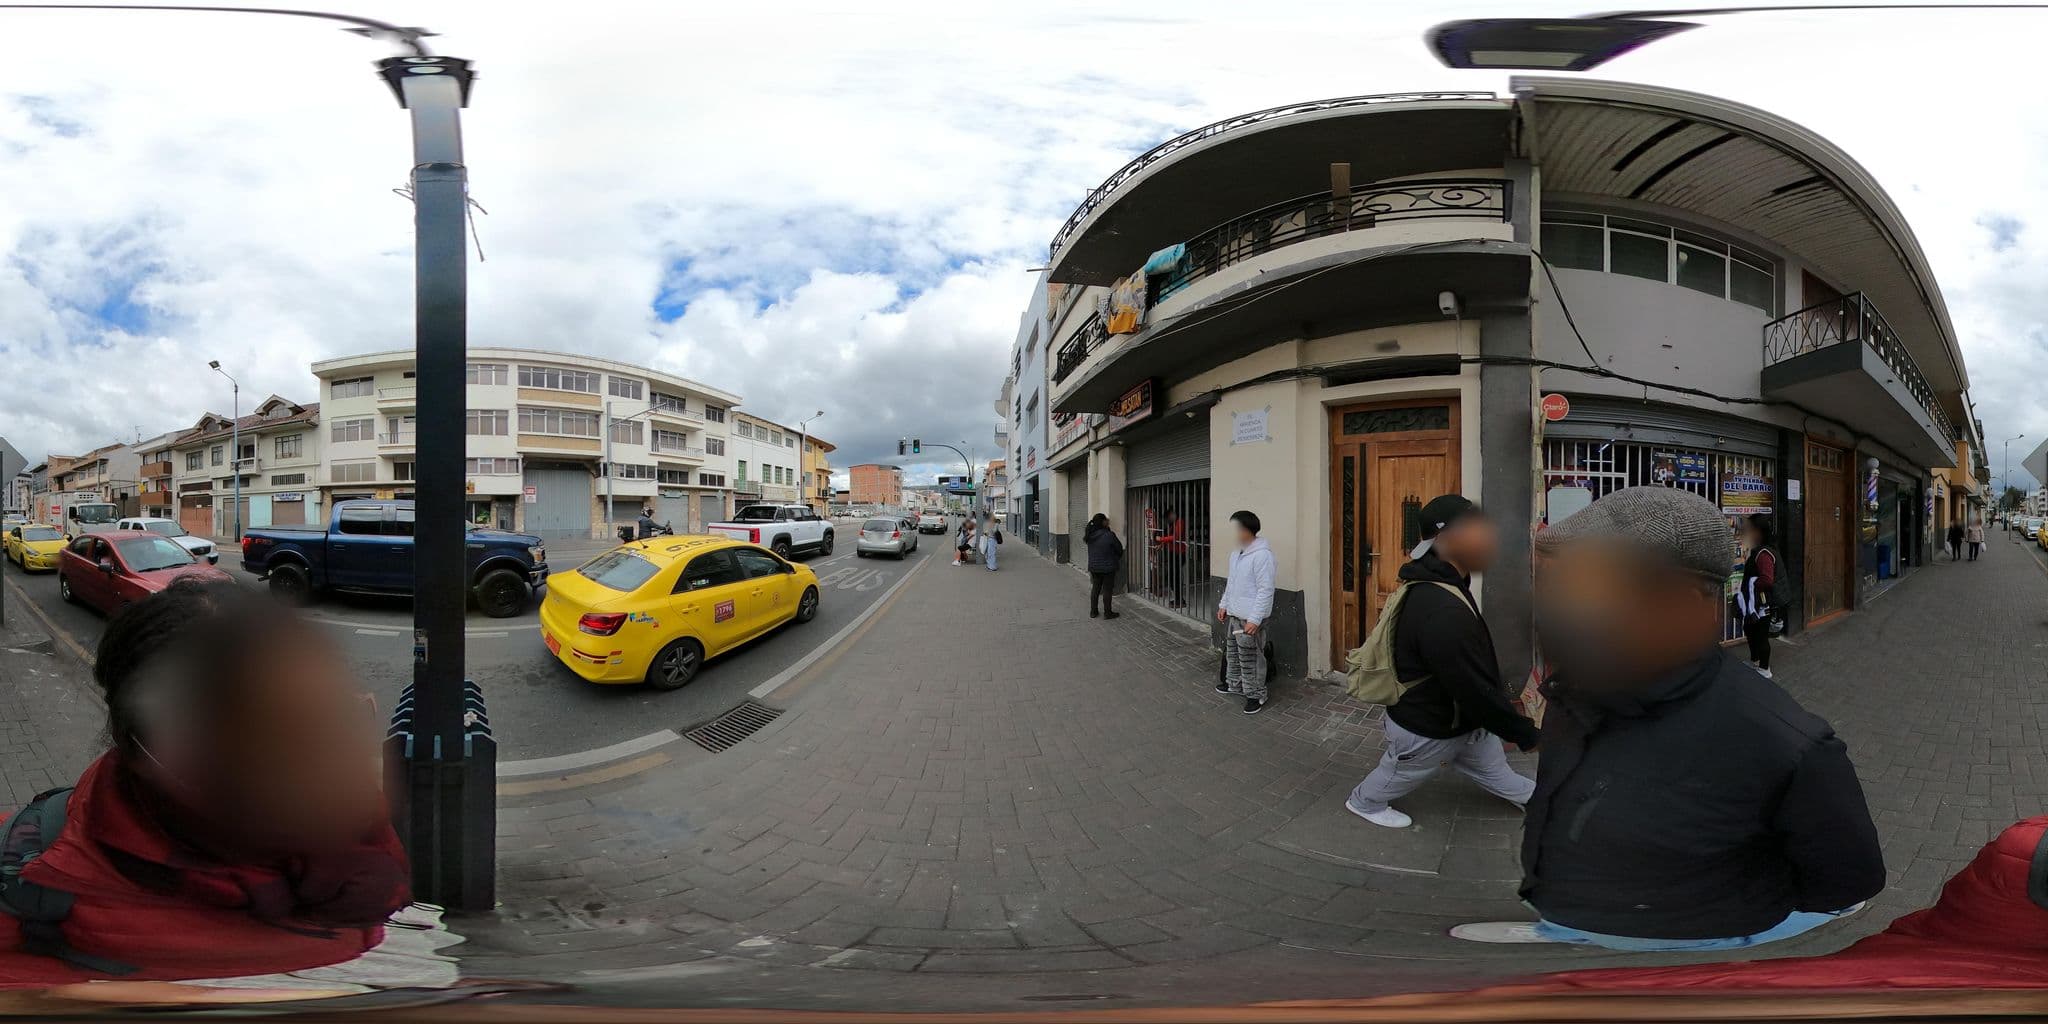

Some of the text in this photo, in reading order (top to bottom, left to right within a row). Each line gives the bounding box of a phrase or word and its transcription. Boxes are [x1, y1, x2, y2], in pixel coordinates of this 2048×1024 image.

[1724, 482, 1773, 492] DEL BARRIO
[820, 567, 884, 592] BUS
